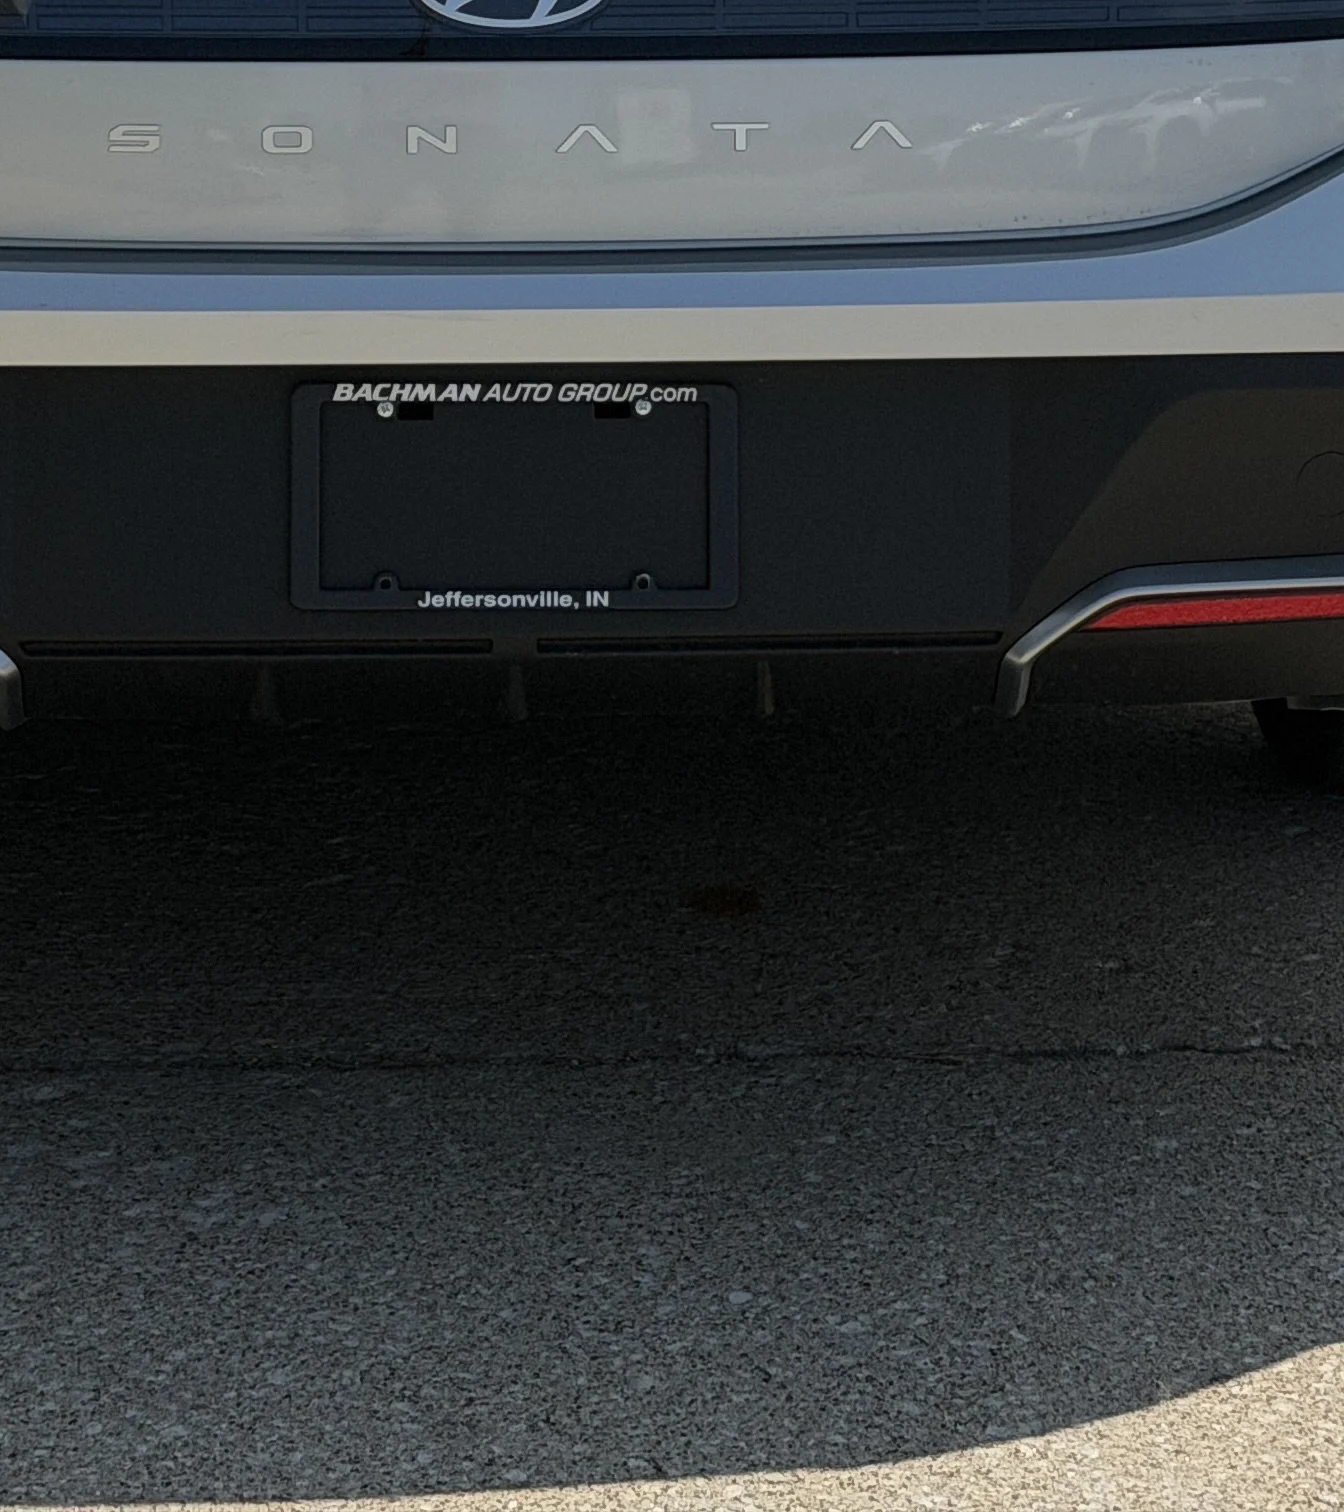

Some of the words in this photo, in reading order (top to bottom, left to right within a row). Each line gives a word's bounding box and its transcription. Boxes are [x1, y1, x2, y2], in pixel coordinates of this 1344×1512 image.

[106, 119, 913, 155] SONATA
[332, 383, 482, 402] BACHMAN
[483, 383, 553, 402] AUTO
[417, 591, 579, 609] Jeffersonville,
[585, 591, 609, 607] IN
